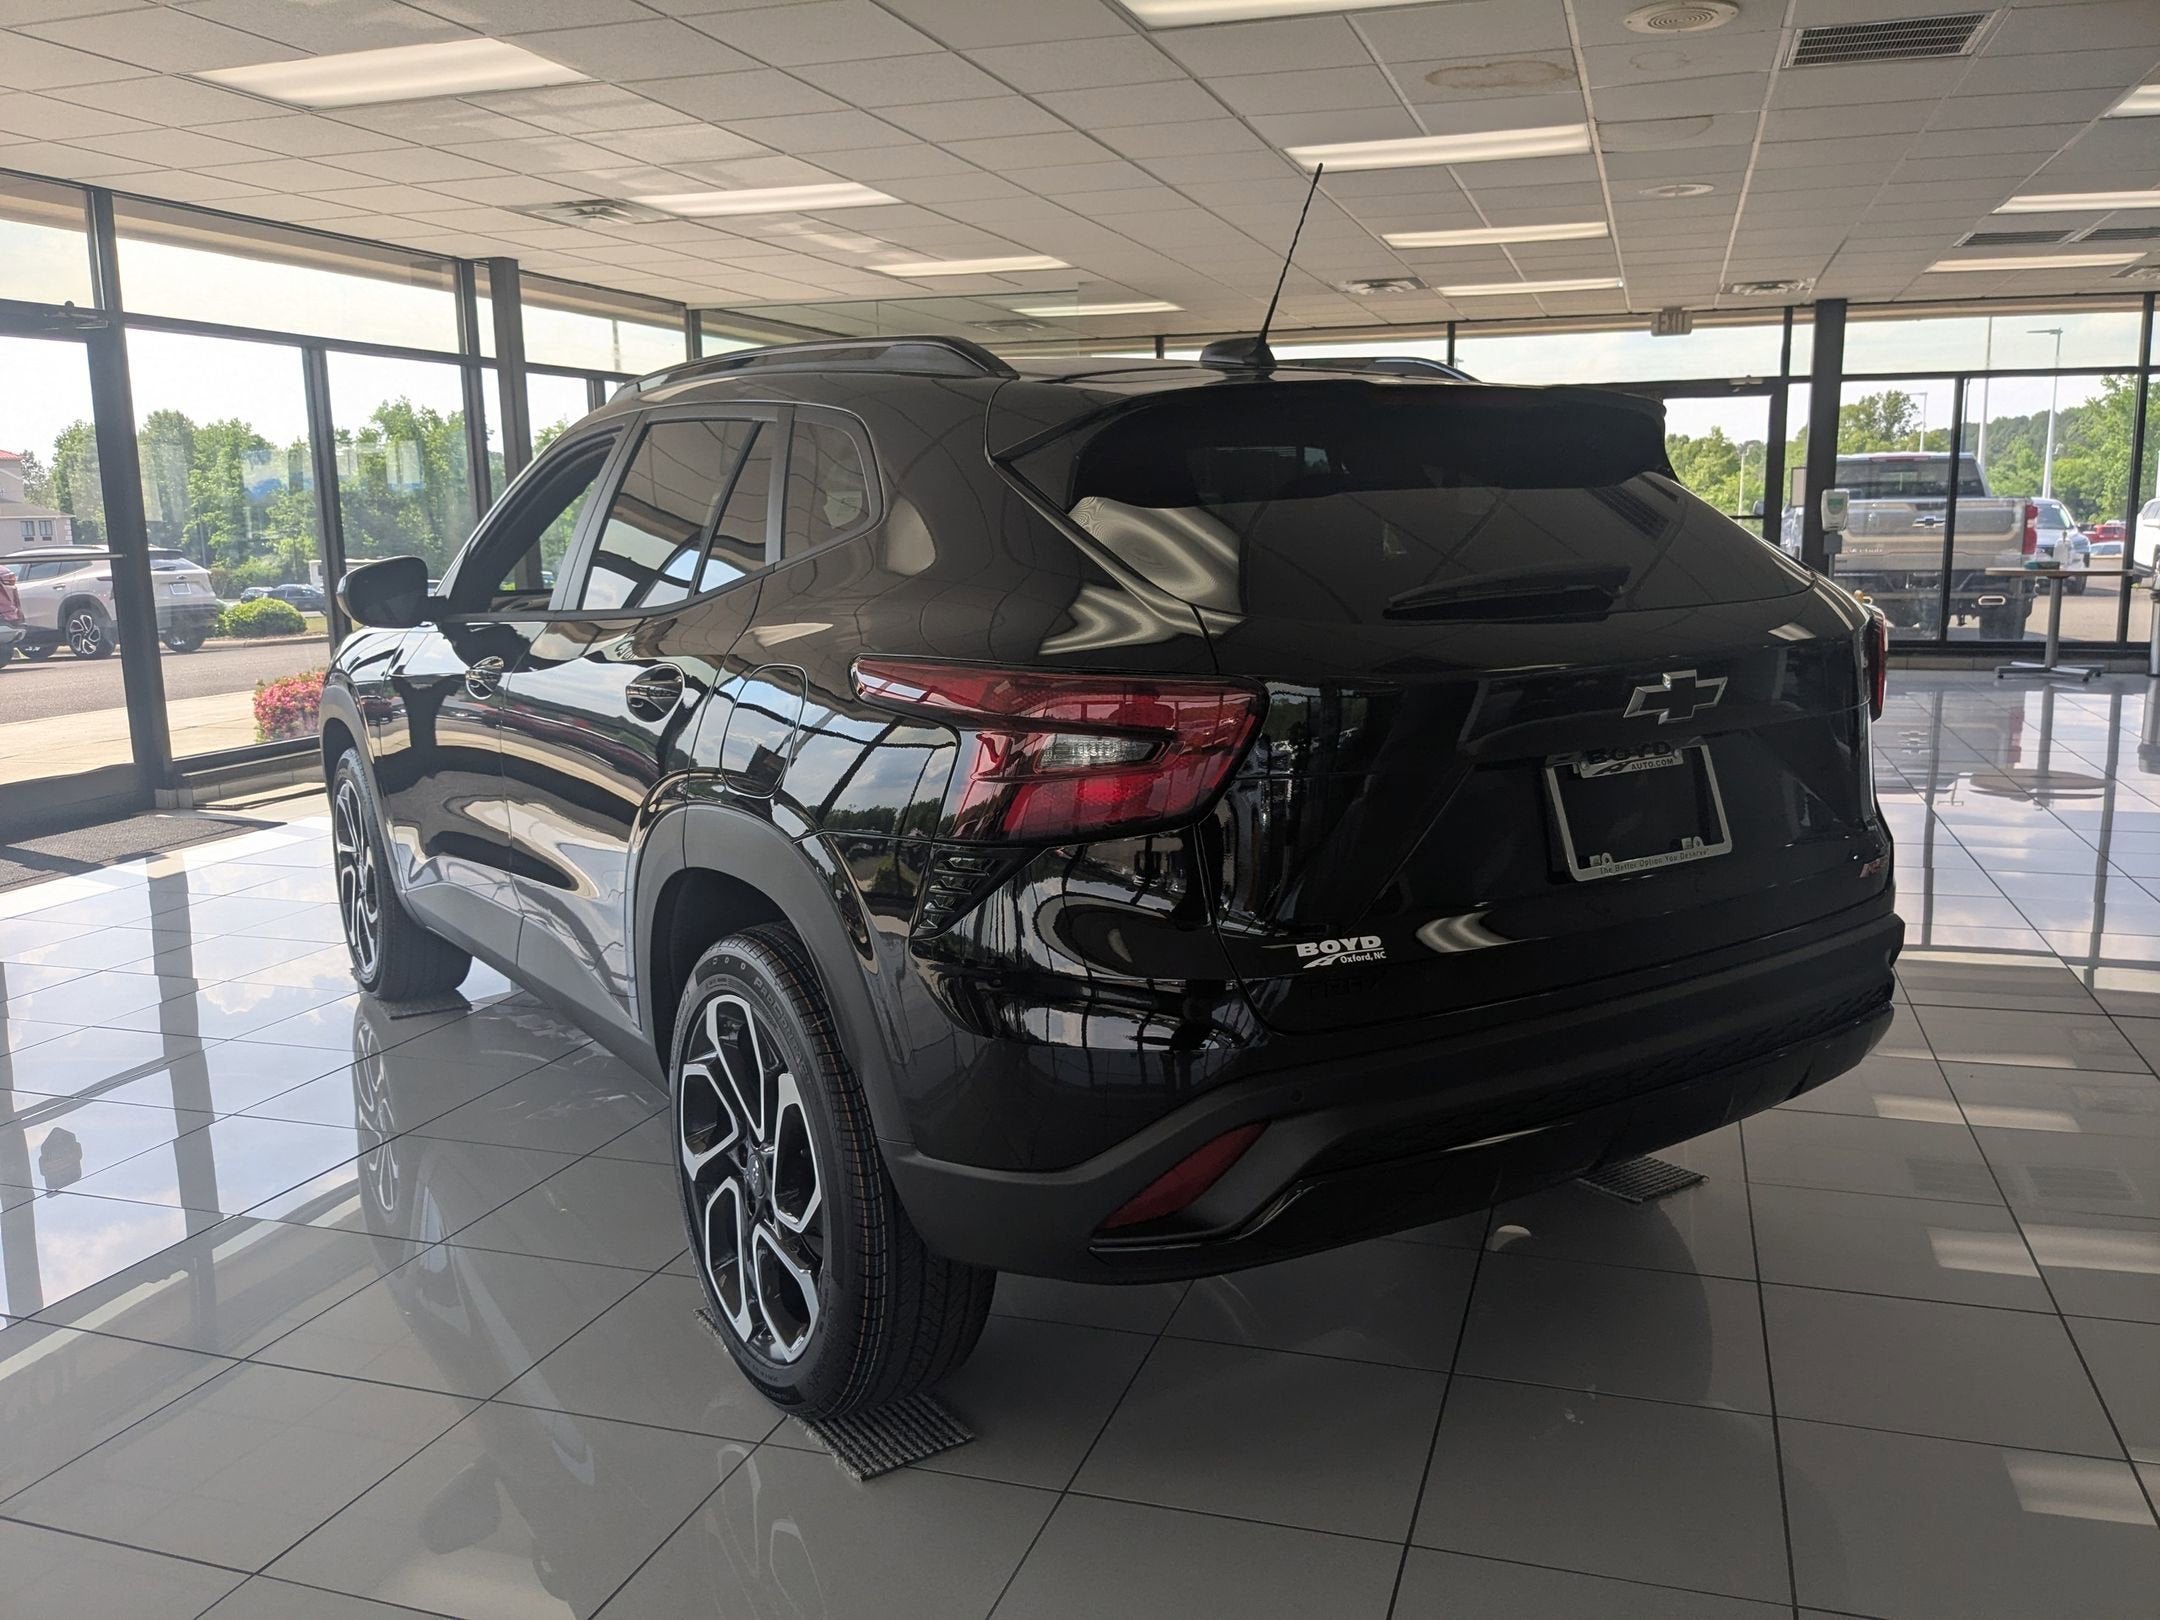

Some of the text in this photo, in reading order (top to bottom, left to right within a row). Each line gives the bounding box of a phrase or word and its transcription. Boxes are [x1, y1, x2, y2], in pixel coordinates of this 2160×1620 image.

[1658, 311, 1687, 332] EXIT
[1631, 758, 1674, 771] AUTO.COM
[1296, 936, 1382, 957] BOYD
[1340, 951, 1387, 964] Oxford, NC
